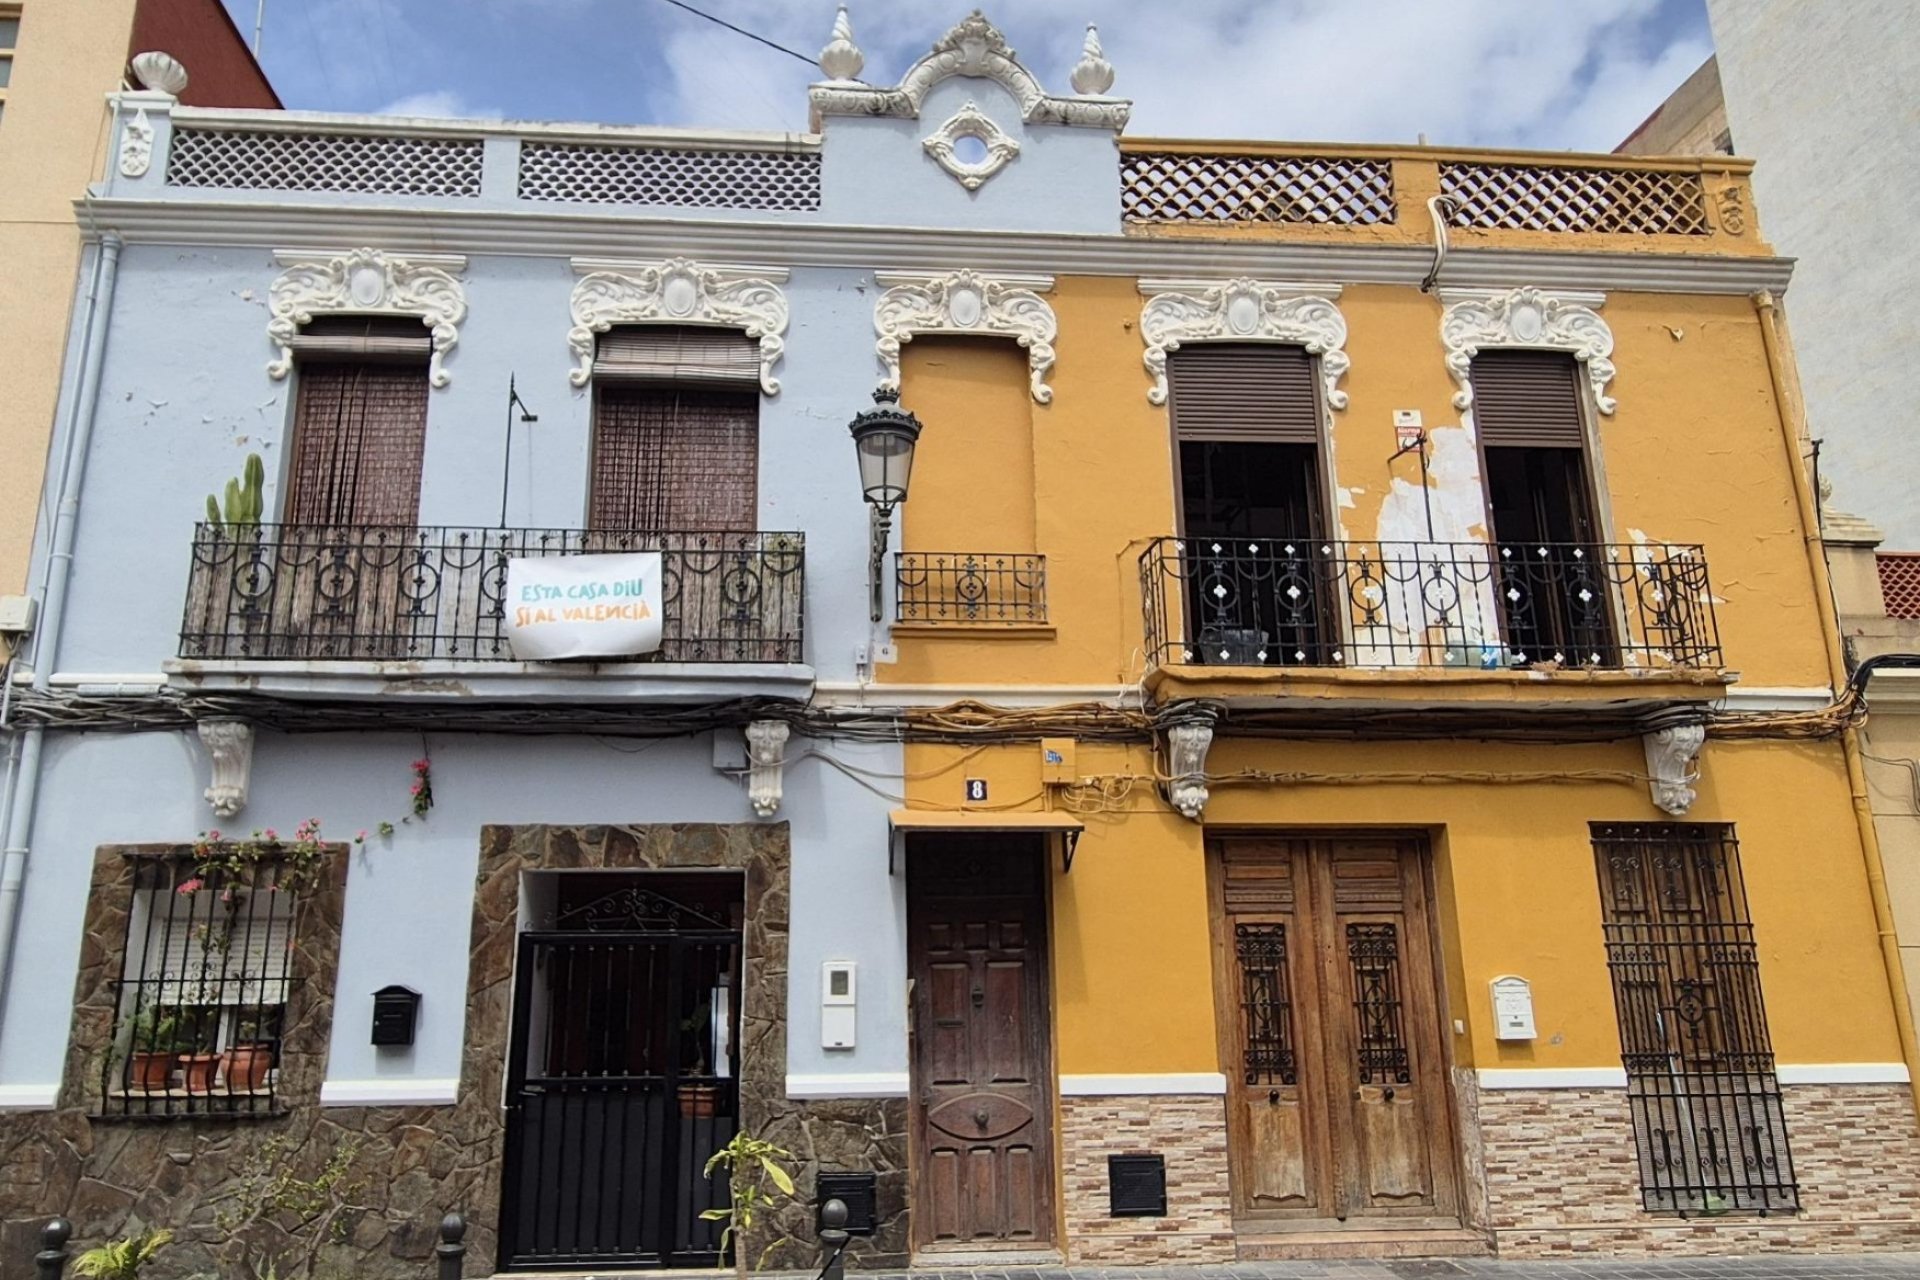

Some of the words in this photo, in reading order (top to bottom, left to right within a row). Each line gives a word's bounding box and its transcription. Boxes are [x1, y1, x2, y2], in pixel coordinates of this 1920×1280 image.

[521, 584, 563, 601] ESTA
[567, 582, 609, 600] CASA
[534, 608, 557, 623] AL
[972, 780, 983, 799] 8
